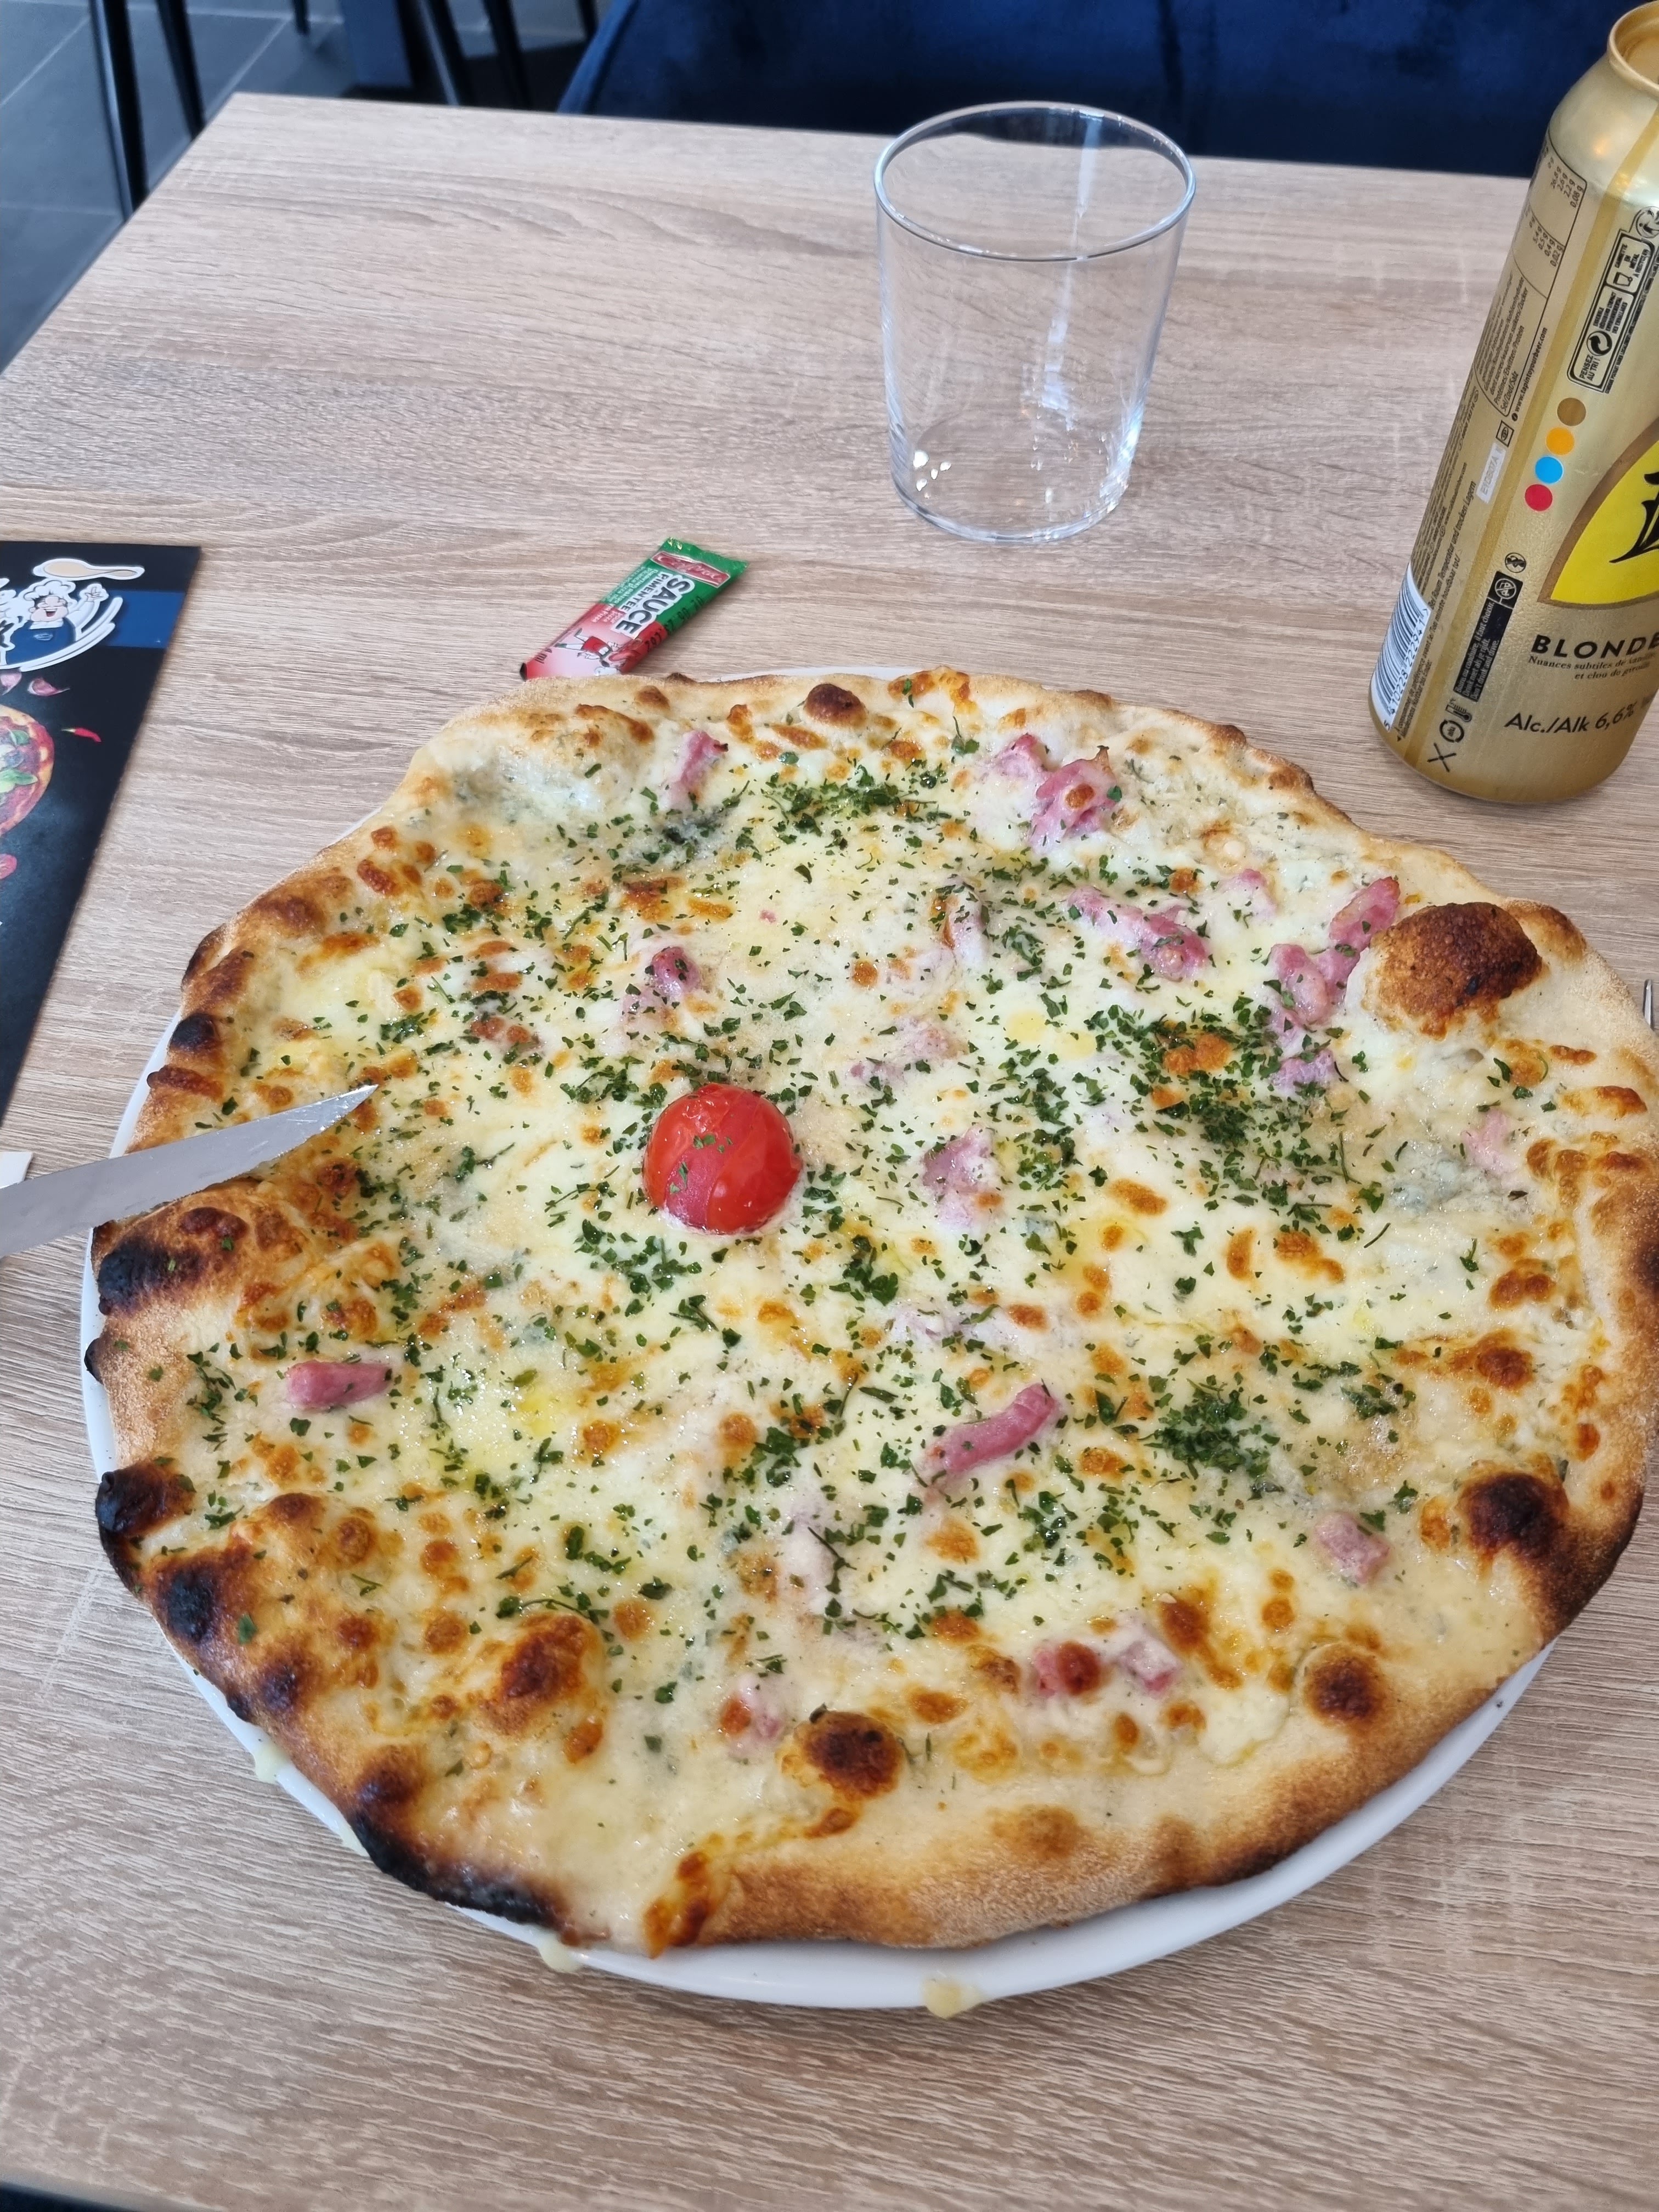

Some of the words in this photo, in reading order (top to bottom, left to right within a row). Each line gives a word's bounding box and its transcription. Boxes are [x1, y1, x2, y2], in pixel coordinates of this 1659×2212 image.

[1562, 184, 1573, 198] 2,2
[1568, 190, 1582, 208] 0,08
[1543, 244, 1553, 257] 0,4
[1549, 250, 1561, 267] 0,02
[1511, 327, 1549, 412] www.tapintoyourbeer.com
[1578, 354, 1594, 379] PENSEZ
[1585, 371, 1595, 381] AU
[1453, 505, 1470, 531] trocken
[1449, 529, 1461, 544] und
[1440, 568, 1457, 600] houdbaar
[614, 576, 692, 635] SAUCE
[1528, 656, 1571, 669] Nuances
[1574, 661, 1612, 670] subtiles
[1615, 658, 1626, 668] de
[1610, 669, 1621, 678] de
[1504, 713, 1590, 733] Alc./Alk
[1594, 701, 1638, 731] 6,6%
